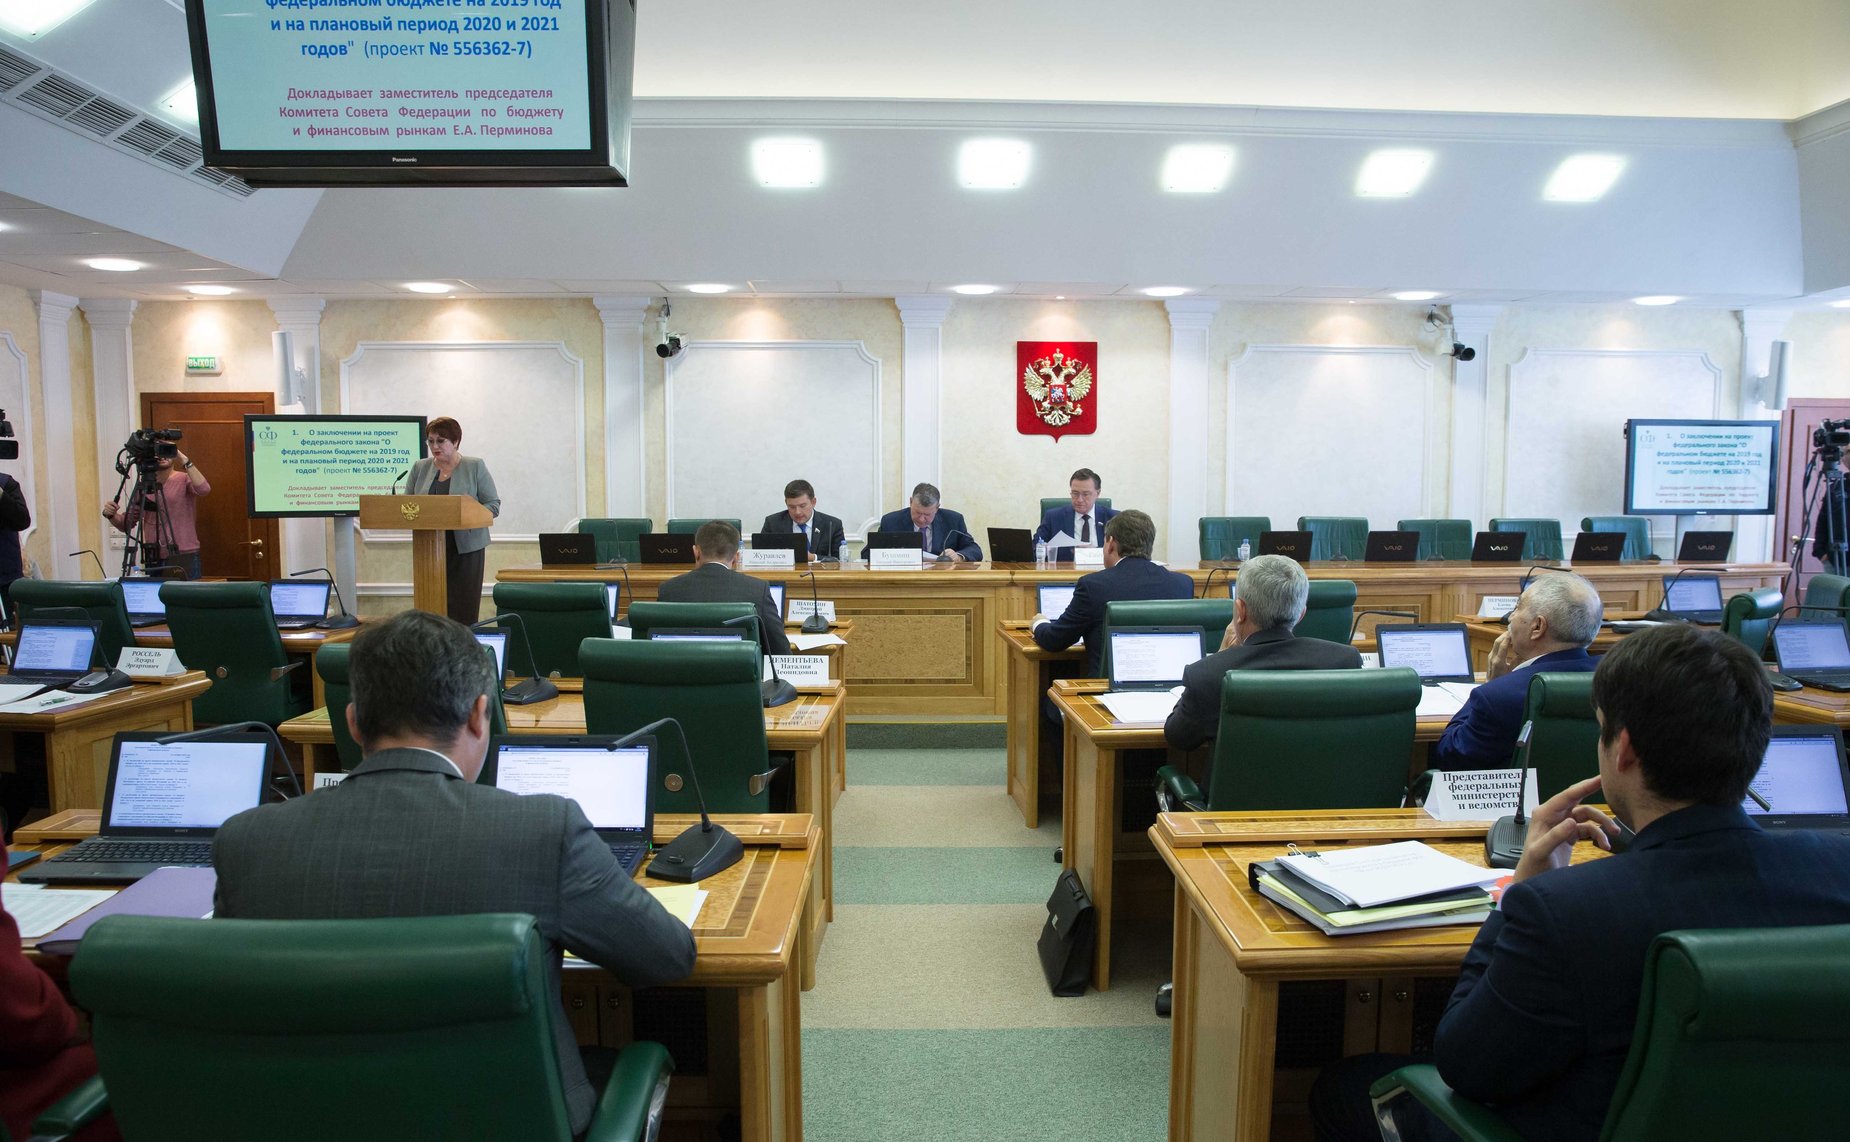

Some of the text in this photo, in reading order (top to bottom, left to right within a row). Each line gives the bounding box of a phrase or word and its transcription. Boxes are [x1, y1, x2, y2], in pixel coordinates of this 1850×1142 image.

[271, 16, 559, 34] и на плановый период 2020 и 2021
[301, 40, 532, 59] годов" (проект № 556362-7)
[287, 88, 553, 101] Докладывает заместитель председателя
[279, 105, 564, 120] Комитета Совета Федерации по бюджету
[293, 124, 553, 138] и финансовым рынкам Е.А. Перминова
[300, 438, 354, 446] федерального
[281, 448, 333, 456] федеральном
[1443, 771, 1527, 783] Представител
[1452, 791, 1520, 801] министерст
